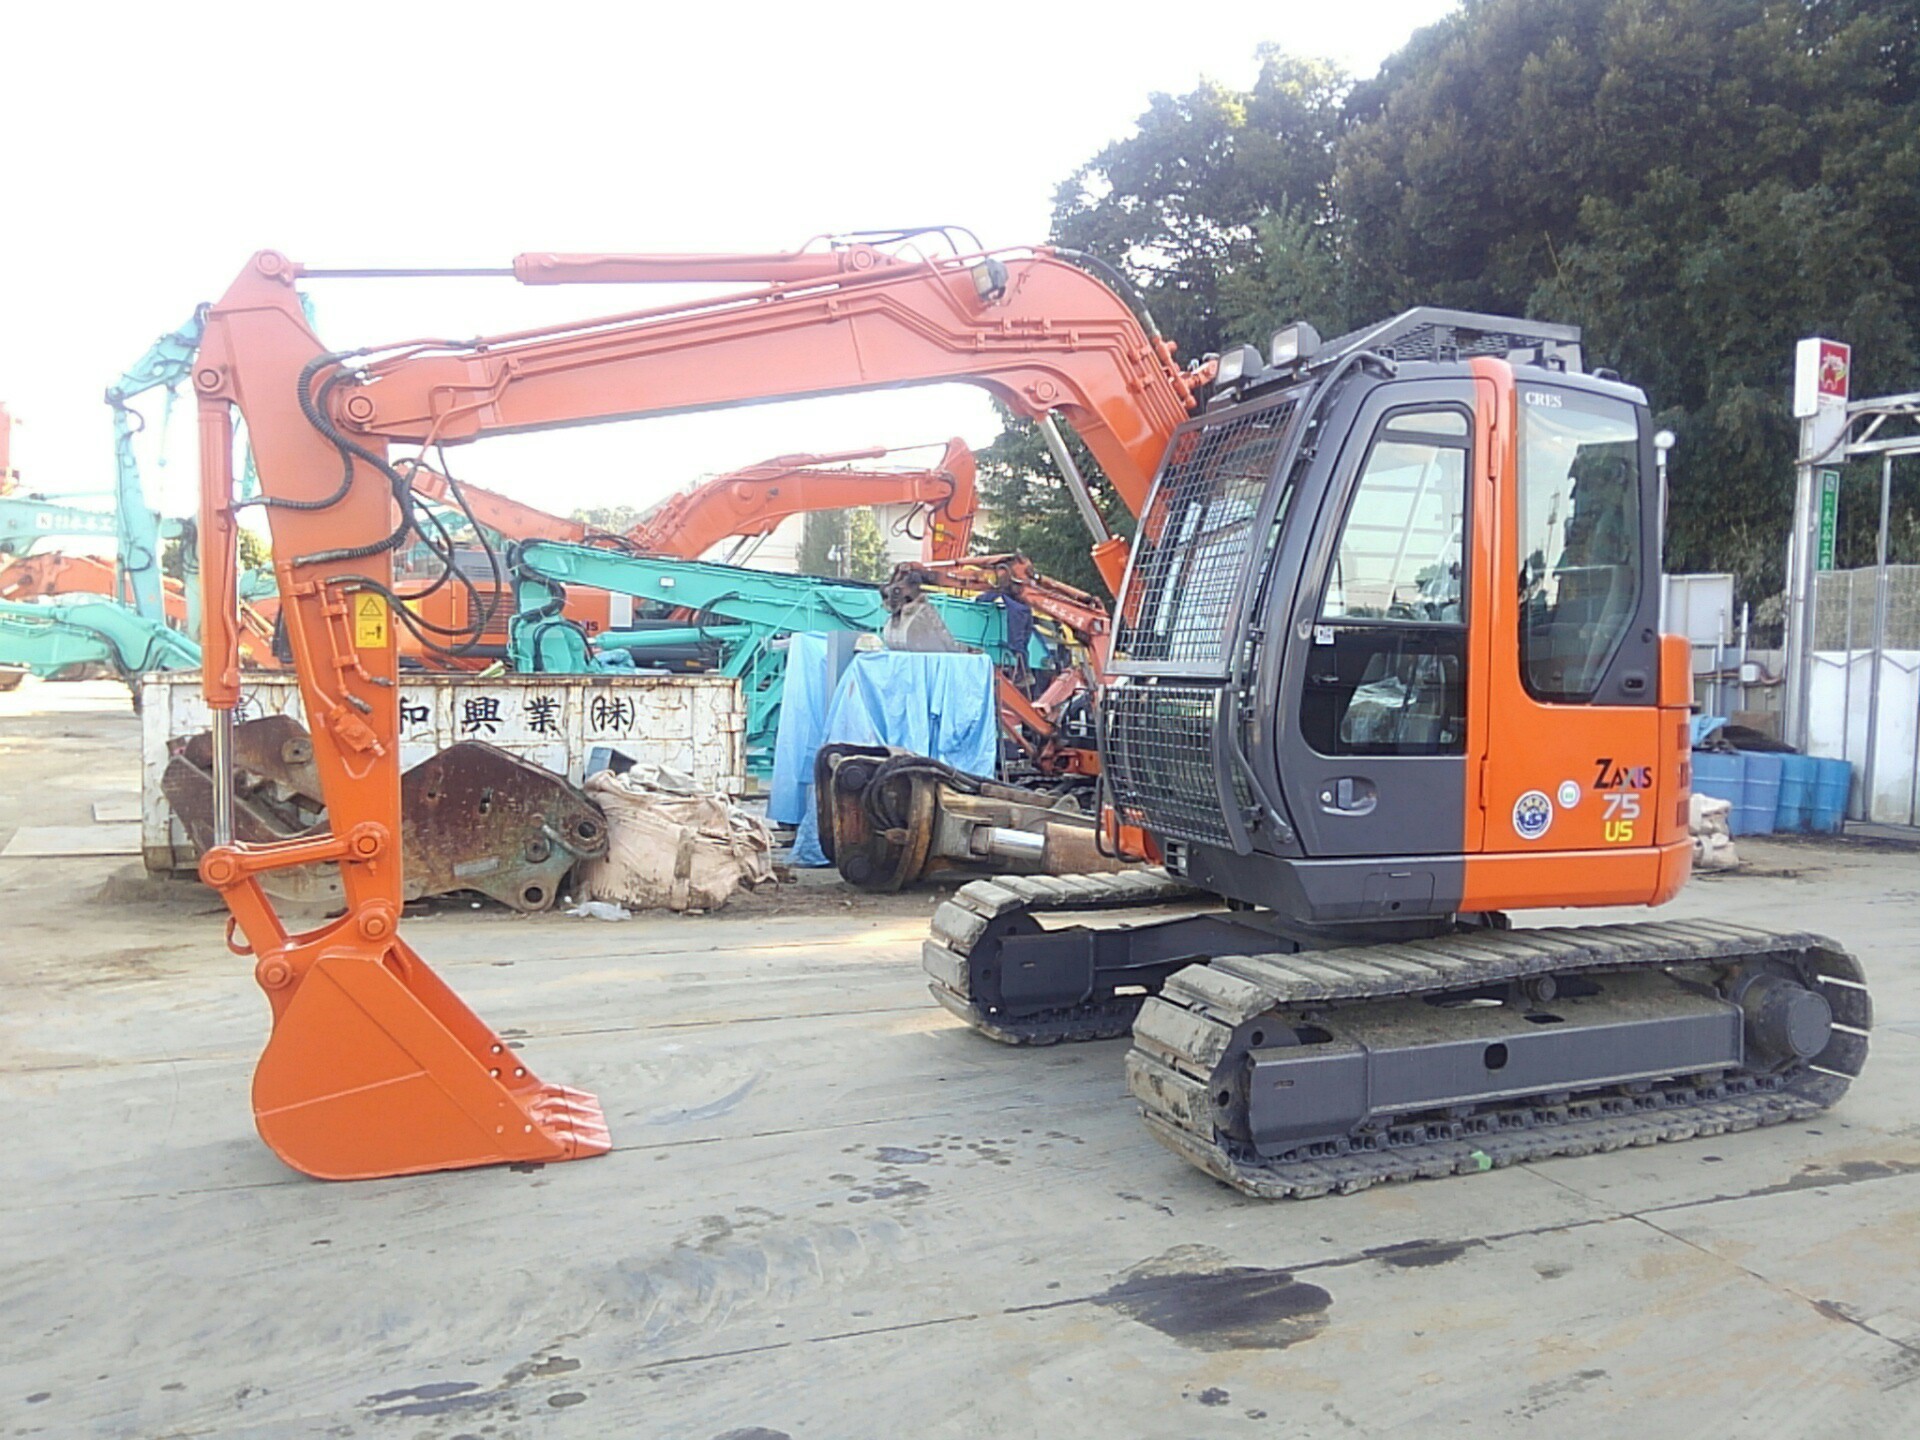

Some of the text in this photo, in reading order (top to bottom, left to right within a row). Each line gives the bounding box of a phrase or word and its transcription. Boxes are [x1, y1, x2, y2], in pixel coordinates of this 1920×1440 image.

[1593, 757, 1653, 790] ZAXIS
[1602, 792, 1641, 820] 75
[1604, 820, 1634, 842] US
